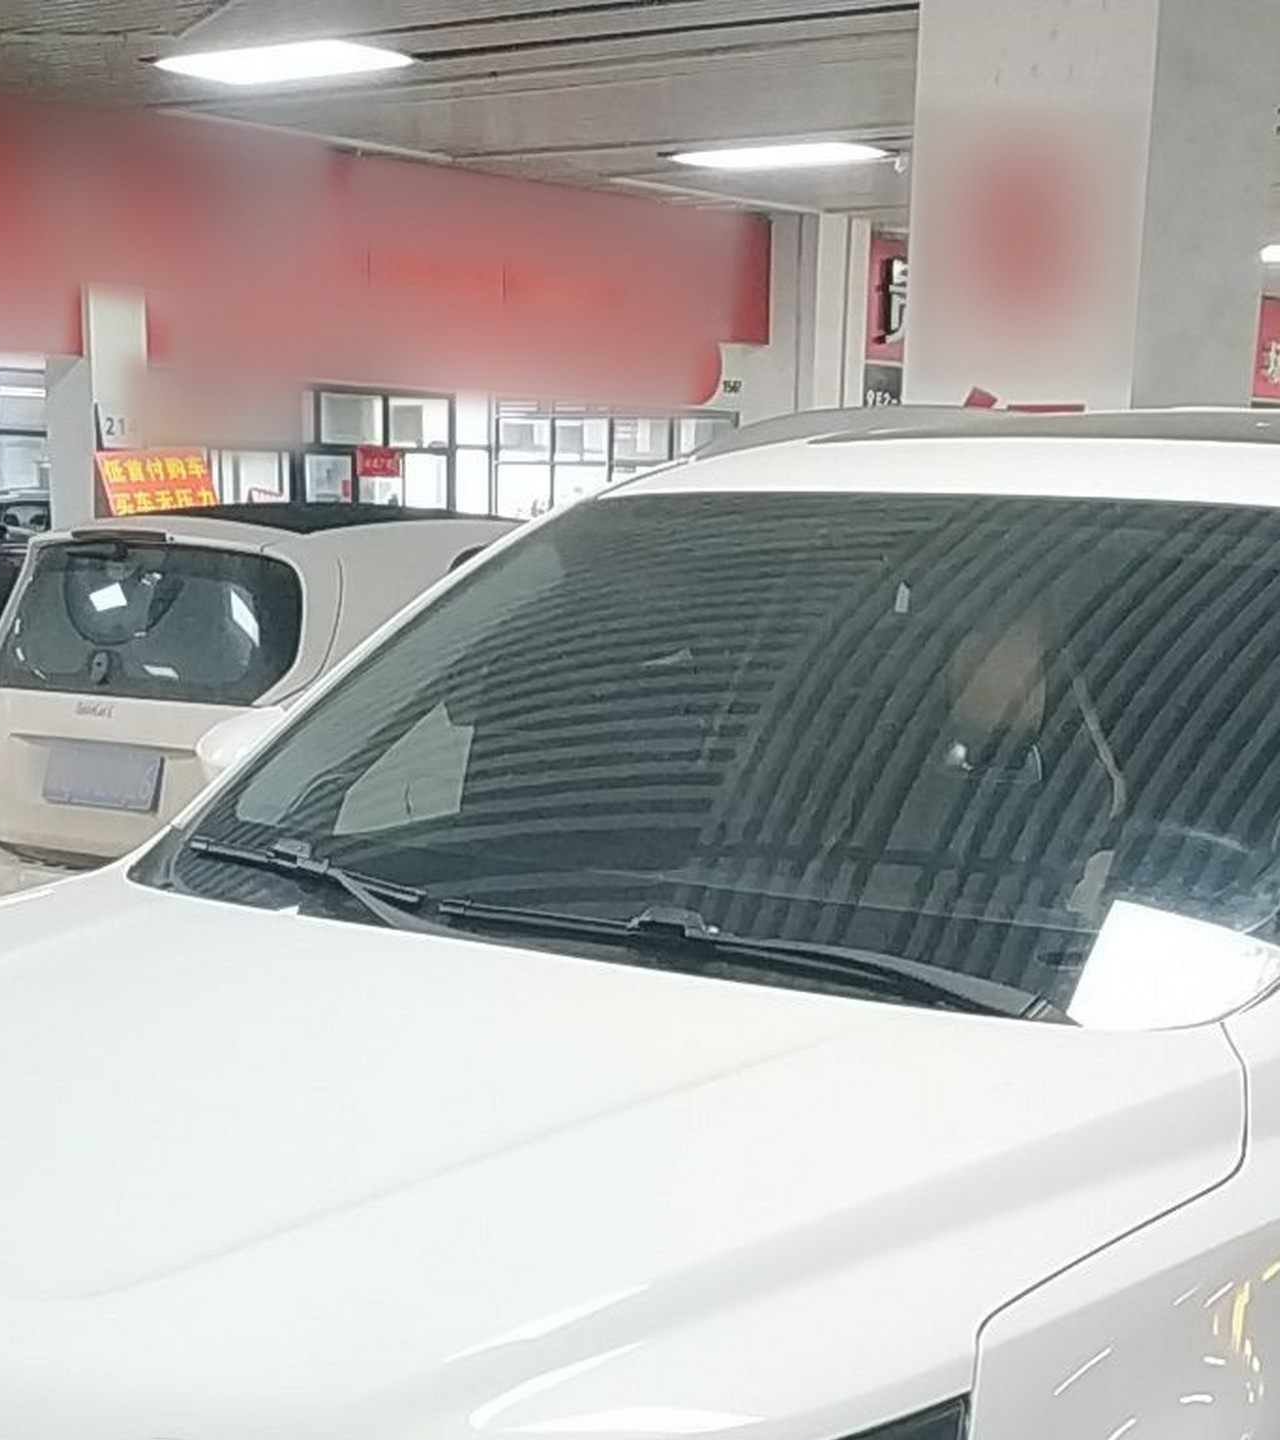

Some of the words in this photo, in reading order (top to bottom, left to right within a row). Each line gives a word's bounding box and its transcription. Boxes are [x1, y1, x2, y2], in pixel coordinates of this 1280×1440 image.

[104, 457, 205, 482] 低首付购车
